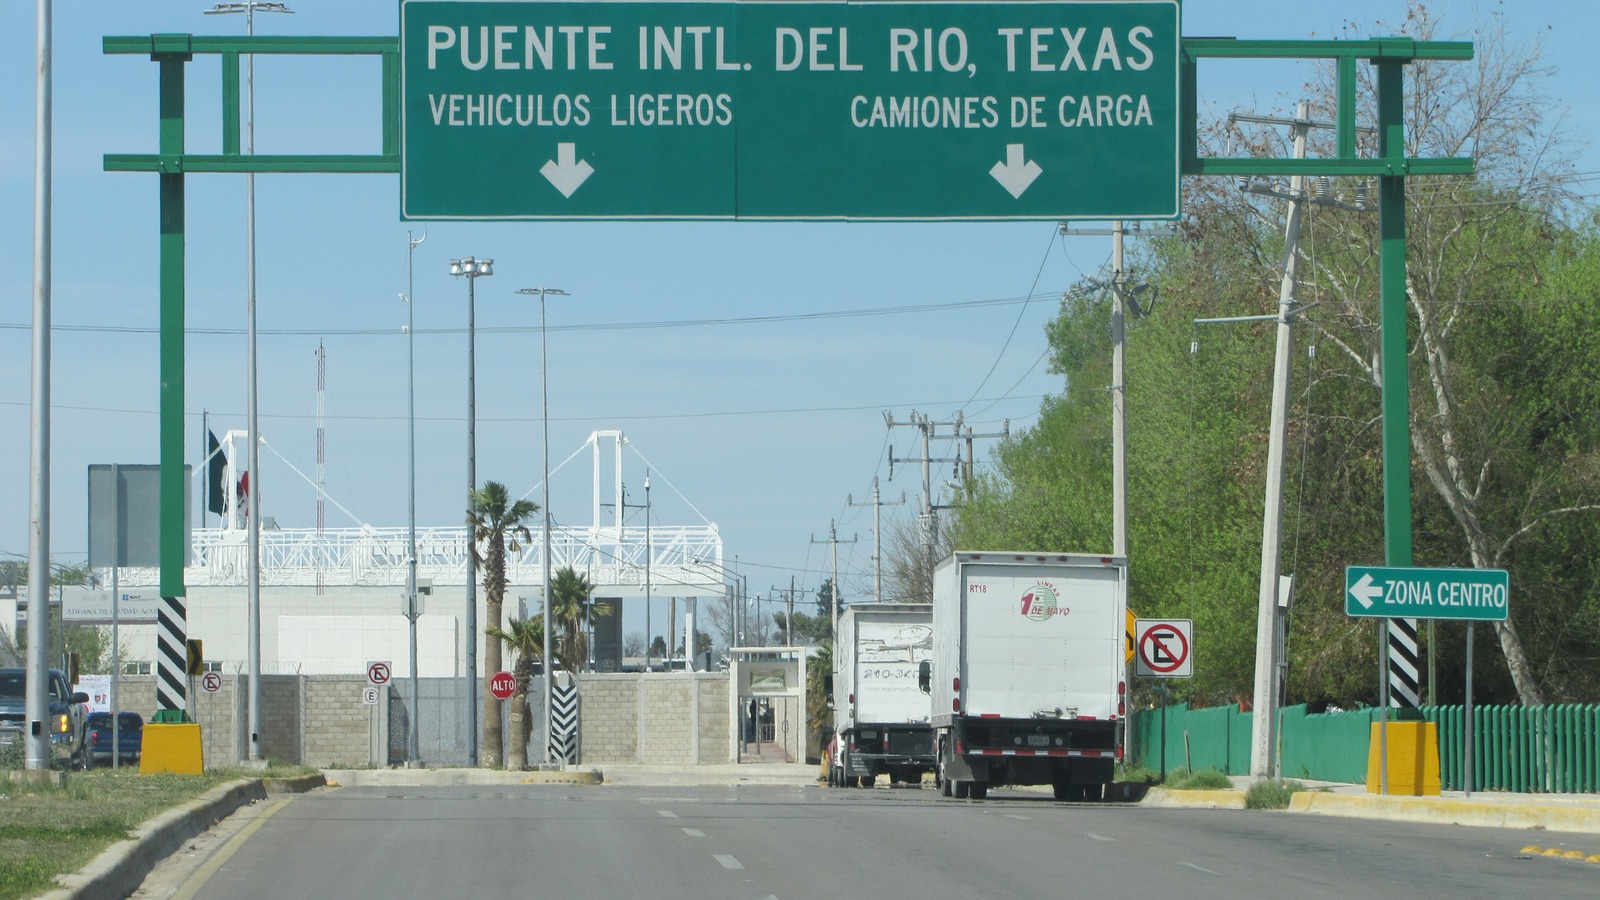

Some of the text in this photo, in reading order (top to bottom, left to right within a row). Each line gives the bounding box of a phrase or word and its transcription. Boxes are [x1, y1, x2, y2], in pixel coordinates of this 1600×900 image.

[428, 25, 1154, 78] PUENTE INTL. DEL RIO, TEXAS
[428, 94, 732, 126] VEHICULOS LIGEROS
[851, 94, 1153, 128] CAMIONES DE CARGA
[970, 585, 987, 593] RT18
[1036, 580, 1060, 597] LINEAS
[1384, 580, 1506, 608] ZONA CENTRO
[1031, 606, 1042, 615] DE
[492, 680, 515, 691] ALTO
[368, 691, 375, 701] E
